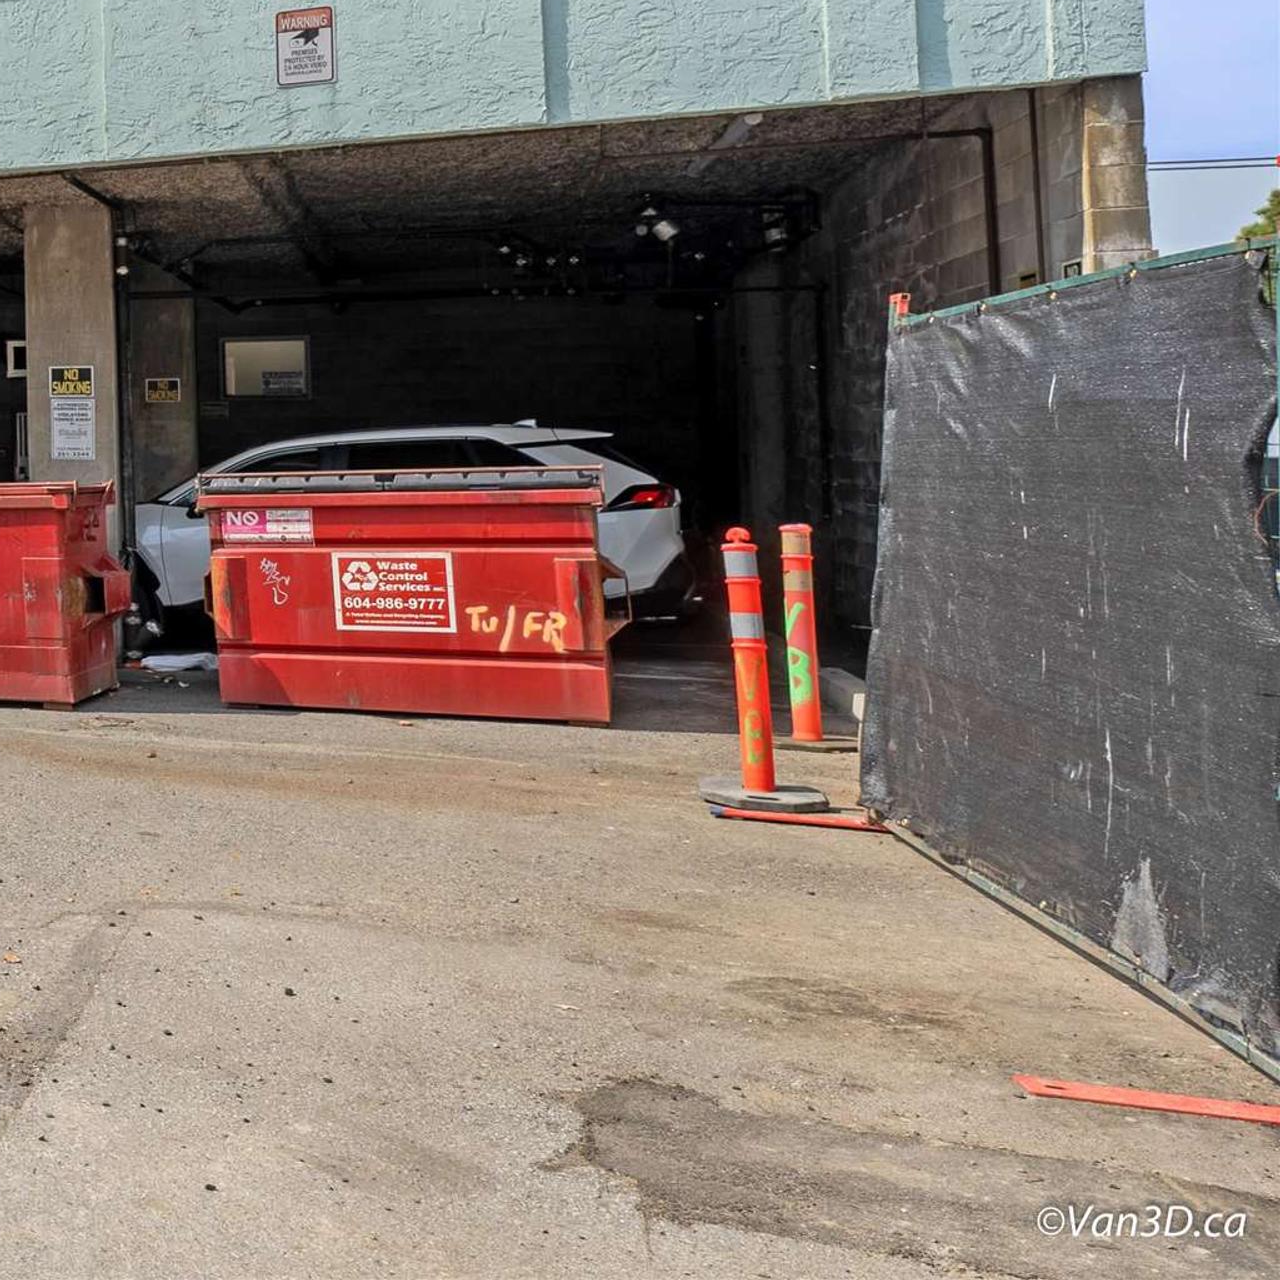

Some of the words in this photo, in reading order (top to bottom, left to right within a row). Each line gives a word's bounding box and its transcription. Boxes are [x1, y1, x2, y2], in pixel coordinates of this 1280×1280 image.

[281, 14, 328, 30] WARNING
[64, 369, 79, 380] NO
[52, 381, 91, 395] SMOKING
[158, 379, 168, 390] NO
[226, 511, 259, 527] NO
[376, 561, 418, 570] Waste
[379, 572, 428, 581] Control
[378, 582, 431, 592] Services
[344, 596, 446, 610] 604-986-9777
